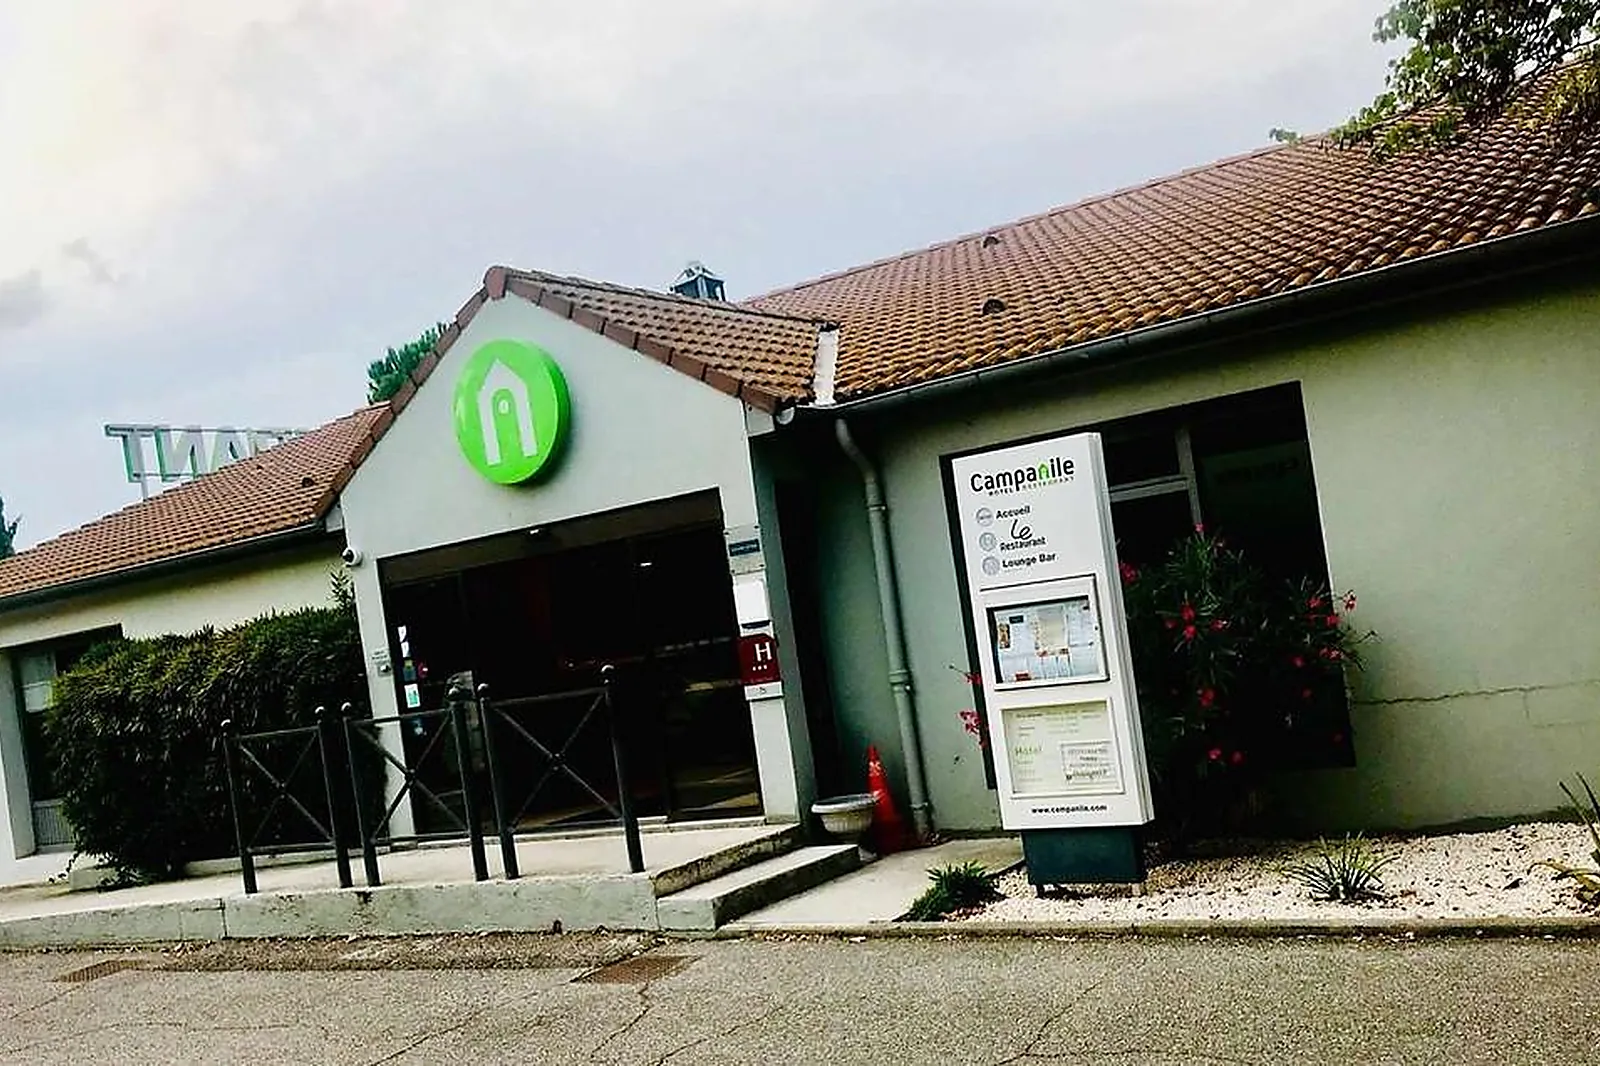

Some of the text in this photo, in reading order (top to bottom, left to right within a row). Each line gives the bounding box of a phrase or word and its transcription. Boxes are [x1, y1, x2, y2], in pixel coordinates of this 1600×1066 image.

[970, 457, 1075, 492] Campanile
[995, 505, 1031, 520] Accueil
[1000, 536, 1046, 551] Restaurant
[1002, 553, 1056, 568] Lounge Bar
[754, 641, 772, 662] H
